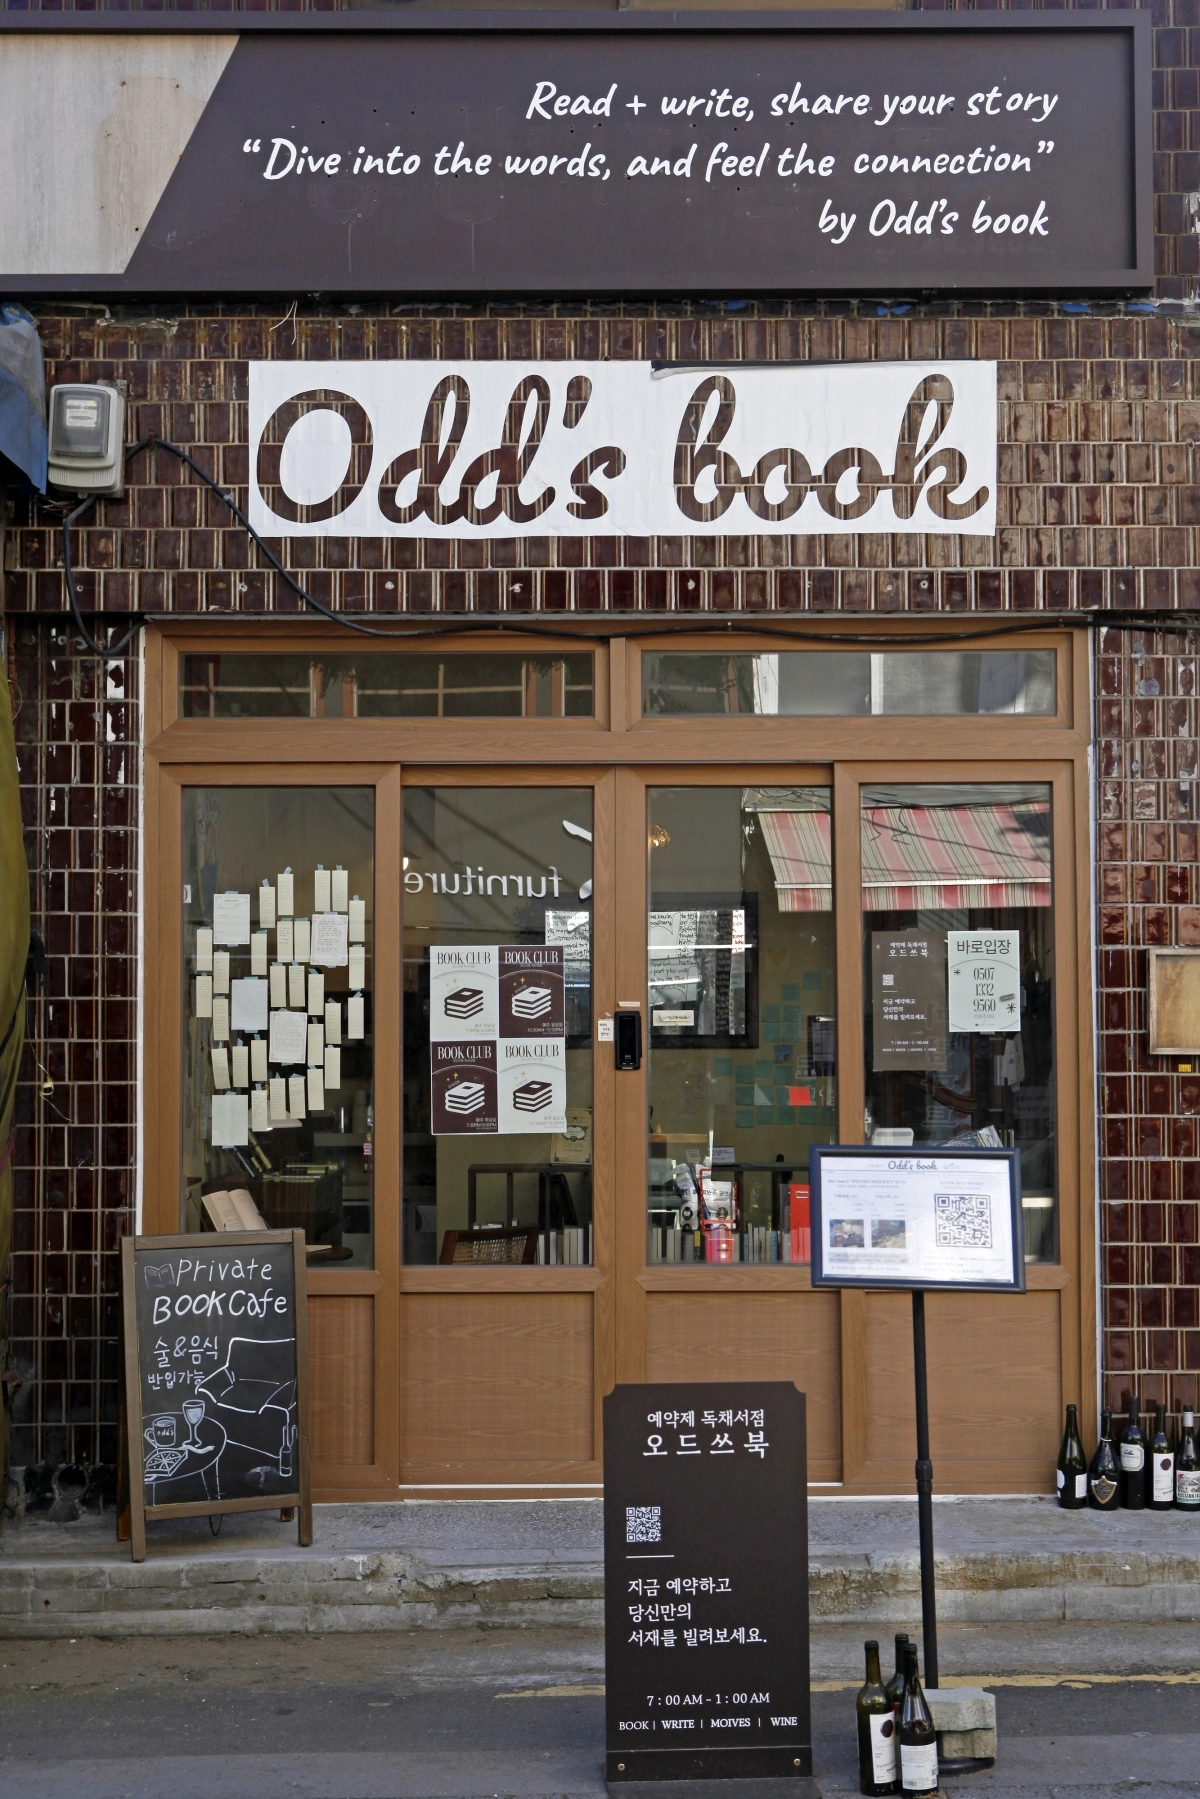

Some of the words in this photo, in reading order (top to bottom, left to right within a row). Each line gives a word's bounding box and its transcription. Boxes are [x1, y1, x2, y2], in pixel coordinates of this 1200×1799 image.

[526, 81, 617, 119] Read
[661, 89, 754, 121] write,
[770, 82, 870, 117] share
[874, 94, 955, 125] your
[967, 86, 1058, 122] story
[353, 146, 420, 175] into
[434, 141, 492, 176] the
[505, 143, 610, 181] words,
[626, 143, 692, 178] and
[705, 142, 767, 183] feel
[778, 142, 835, 177] the
[819, 199, 856, 244] by
[869, 199, 957, 236] Odd’s
[971, 200, 1049, 236] book
[256, 374, 627, 525] Odd's
[673, 374, 990, 524] book
[957, 939, 1011, 955] 바로입장
[438, 952, 463, 965] BOOK
[466, 952, 491, 965] CLUB
[505, 951, 531, 964] BOOK
[533, 951, 559, 964] CLUB
[973, 967, 995, 980] 0507
[975, 983, 994, 996] 1332
[973, 999, 996, 1012] 9560
[438, 1046, 464, 1059] BOOK
[467, 1046, 492, 1059] CLUB
[505, 1045, 531, 1058] BOOK
[533, 1045, 559, 1058] CLUB
[888, 1160, 913, 1170] Odd's
[916, 1160, 938, 1170] book
[176, 1258, 273, 1287] Private
[153, 1290, 226, 1325] BOOK
[228, 1288, 288, 1317] Cafe
[147, 1369, 205, 1390] 반입가능
[646, 1410, 695, 1428] 예약제
[701, 1408, 765, 1429] 독채서점
[627, 1579, 660, 1597] 지금
[666, 1577, 732, 1596] 예약하고
[628, 1603, 692, 1623] 당신만의
[627, 1628, 677, 1648] 서재를
[683, 1627, 767, 1646] 빌려보세요.
[619, 1720, 649, 1731] BOOK
[661, 1719, 695, 1730] WRITE
[711, 1717, 751, 1728] MOIVES
[770, 1716, 798, 1727] WINE
